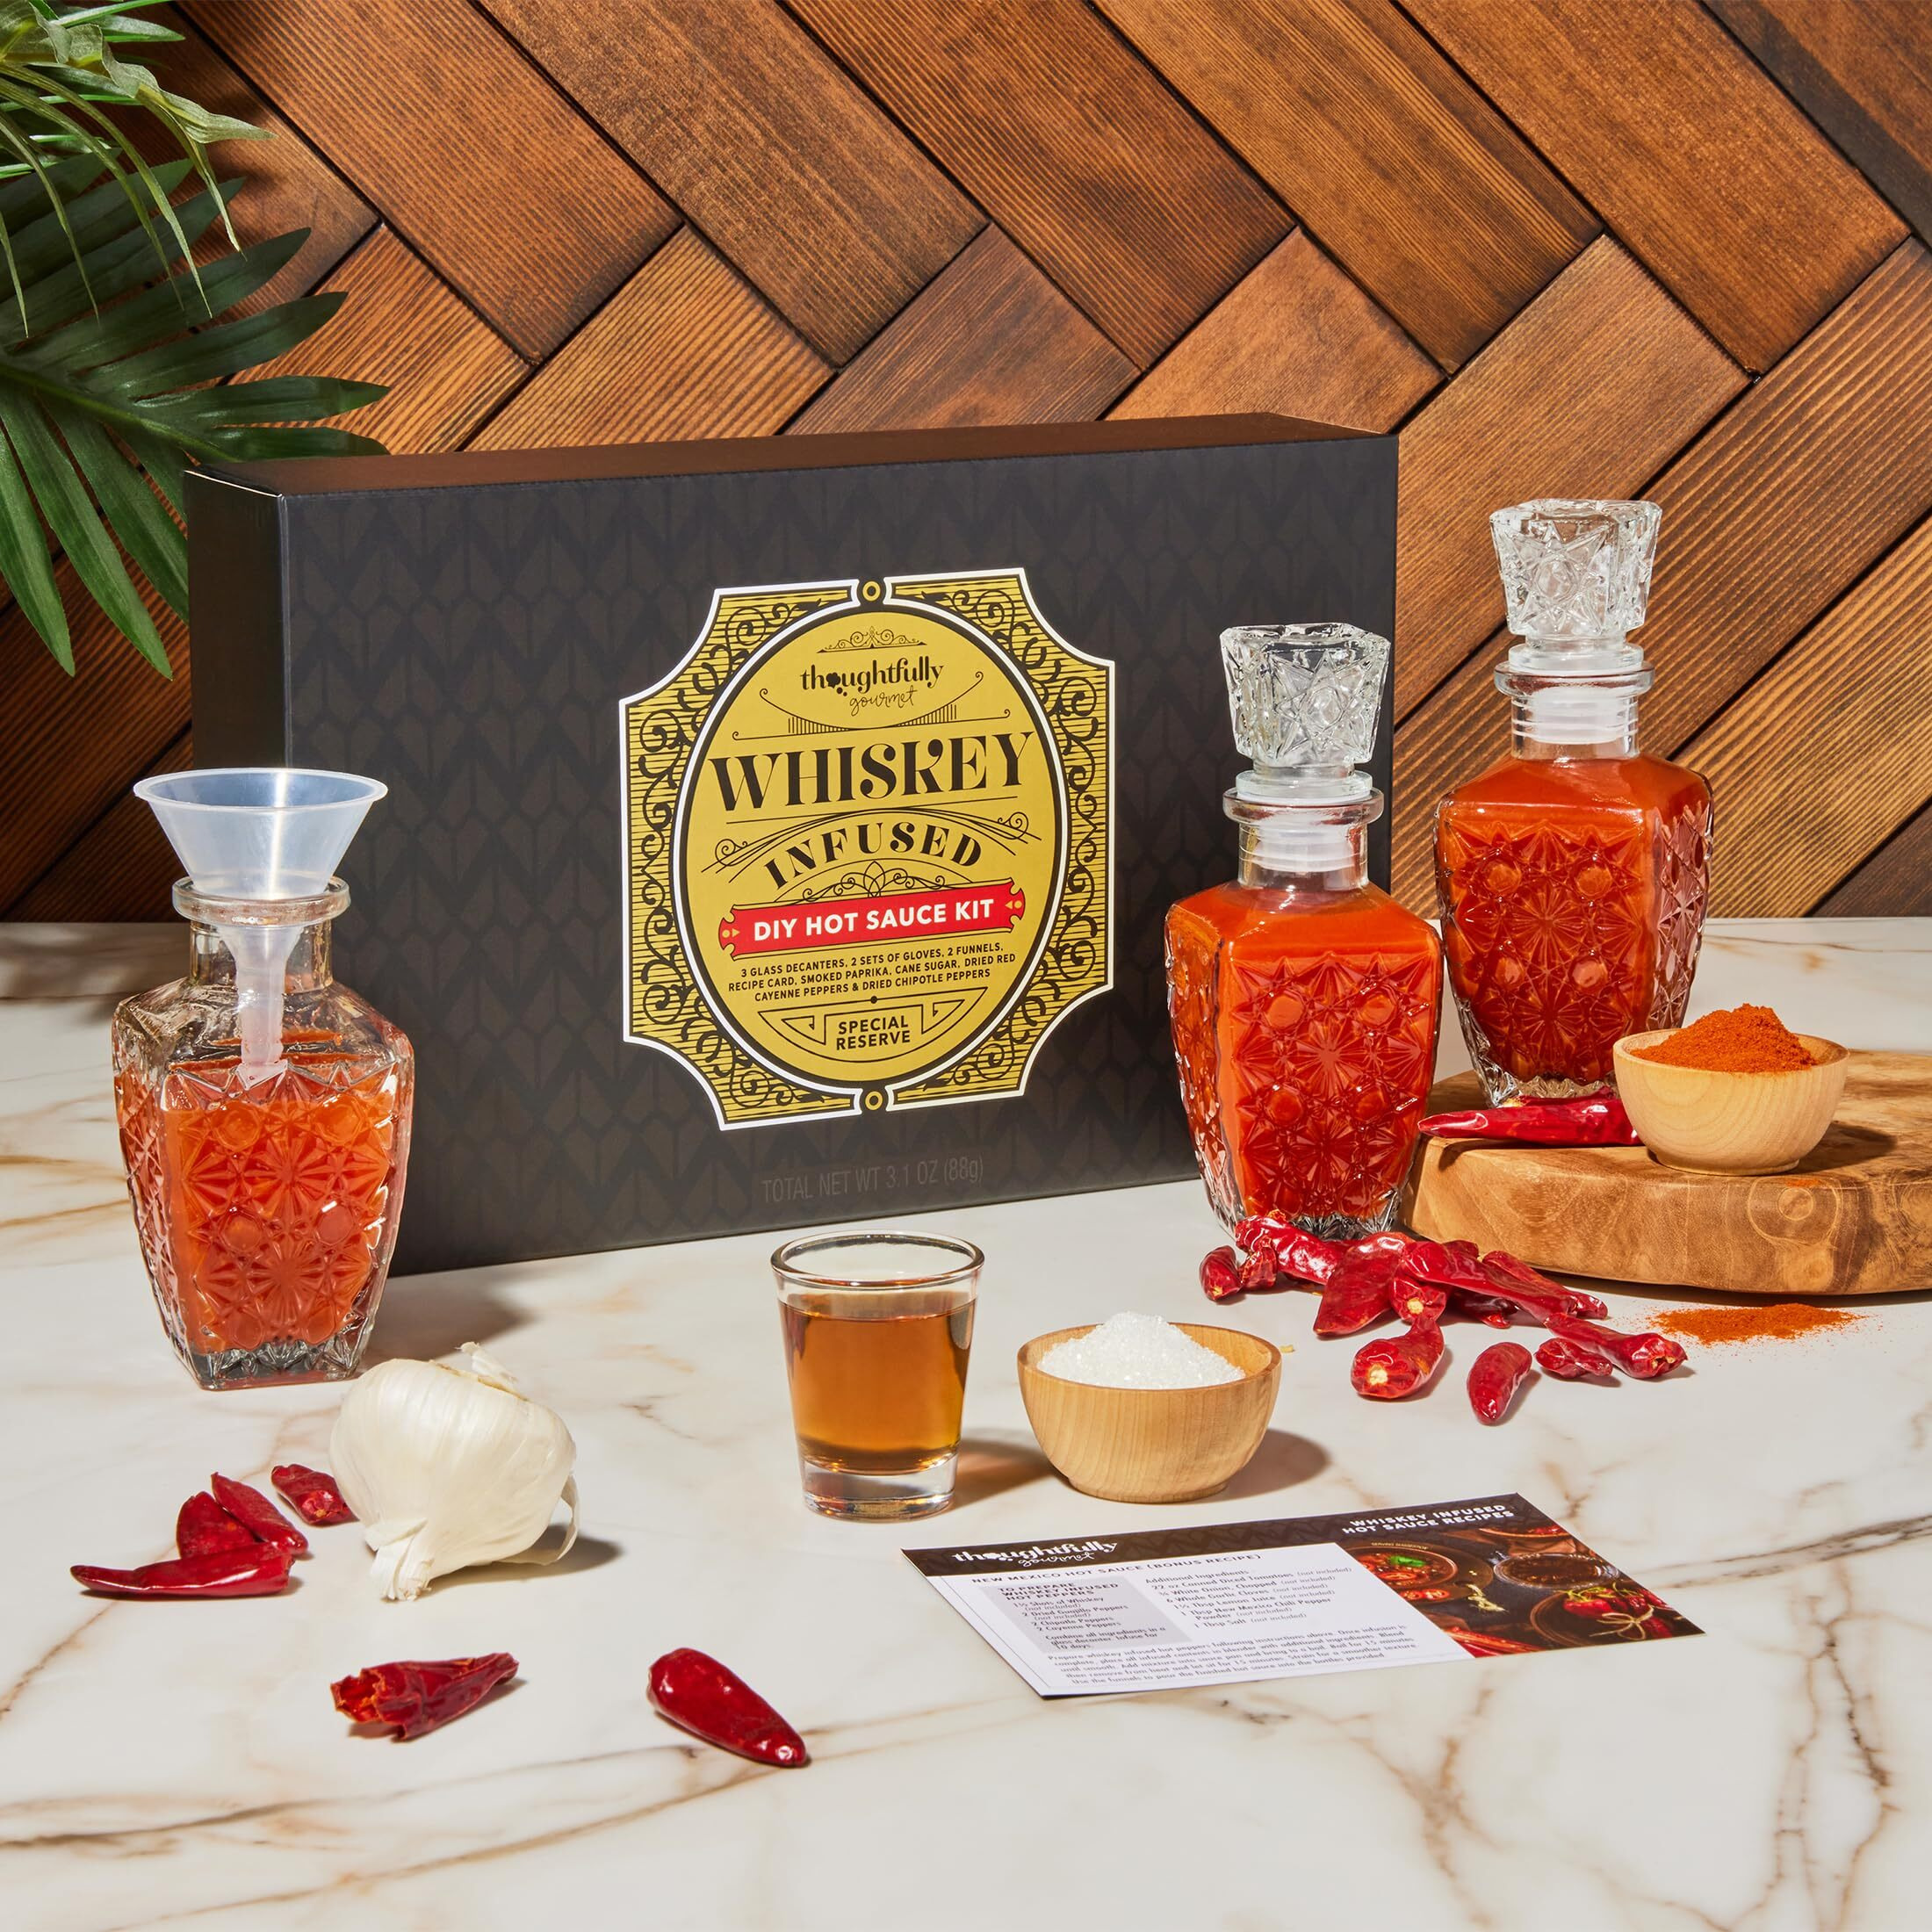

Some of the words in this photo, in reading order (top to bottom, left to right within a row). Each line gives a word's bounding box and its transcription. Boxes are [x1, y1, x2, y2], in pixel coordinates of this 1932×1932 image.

[800, 656, 943, 696] thoughtfully
[849, 686, 917, 717] gourmet
[708, 732, 1034, 811] WHISKEY
[763, 821, 982, 889] INFUSED
[754, 918, 797, 941] DIY
[805, 912, 858, 936] HOT
[866, 904, 947, 930] SAUCE
[955, 898, 994, 921] KIT
[728, 980, 765, 991] RECIPE
[768, 977, 797, 988] CARD,
[801, 972, 842, 984] SMOKED
[846, 967, 892, 979] PAPRIKA,
[895, 963, 921, 975] CANE
[925, 960, 961, 971] SUGAR,
[965, 956, 994, 967] DRIED
[997, 954, 1016, 963] RED
[741, 969, 747, 977] 3
[750, 965, 783, 977] GLASS
[786, 958, 848, 973] DECANTERS,
[851, 957, 857, 966] 2
[861, 955, 884, 965] SETS
[887, 953, 900, 962] OF
[903, 948, 944, 962] GLOVES,
[948, 948, 954, 956] 2
[956, 942, 1004, 955] FUNNELS,
[755, 989, 801, 1001] CAYENNE
[804, 984, 849, 997] PEPPERS
[852, 983, 859, 991] &
[862, 979, 892, 991] DRIED
[895, 973, 943, 987] CHIPOTLE
[947, 969, 991, 981] PEPPERS
[836, 1030, 911, 1050] RESERVE
[839, 1015, 908, 1034] SPECIAL
[761, 1177, 814, 1203] TOTAL
[819, 1170, 851, 1196] NET
[855, 1166, 881, 1192] WT
[886, 1164, 910, 1188] 3.1
[917, 1160, 939, 1185] OZ
[944, 1156, 984, 1185] (88g)
[1342, 1525, 1376, 1534] HOT
[1383, 1519, 1439, 1531] SAUCE
[1442, 1510, 1514, 1525] RECIPES
[1350, 1513, 1426, 1527] WHISKEY
[1432, 1504, 1506, 1519] INFUSED
[952, 1540, 1118, 1562] thoughtfully
[1018, 1552, 1095, 1567] gourmet
[1205, 1554, 1261, 1563] RECIPE)
[1035, 1590, 1094, 1598] PEPPERS
